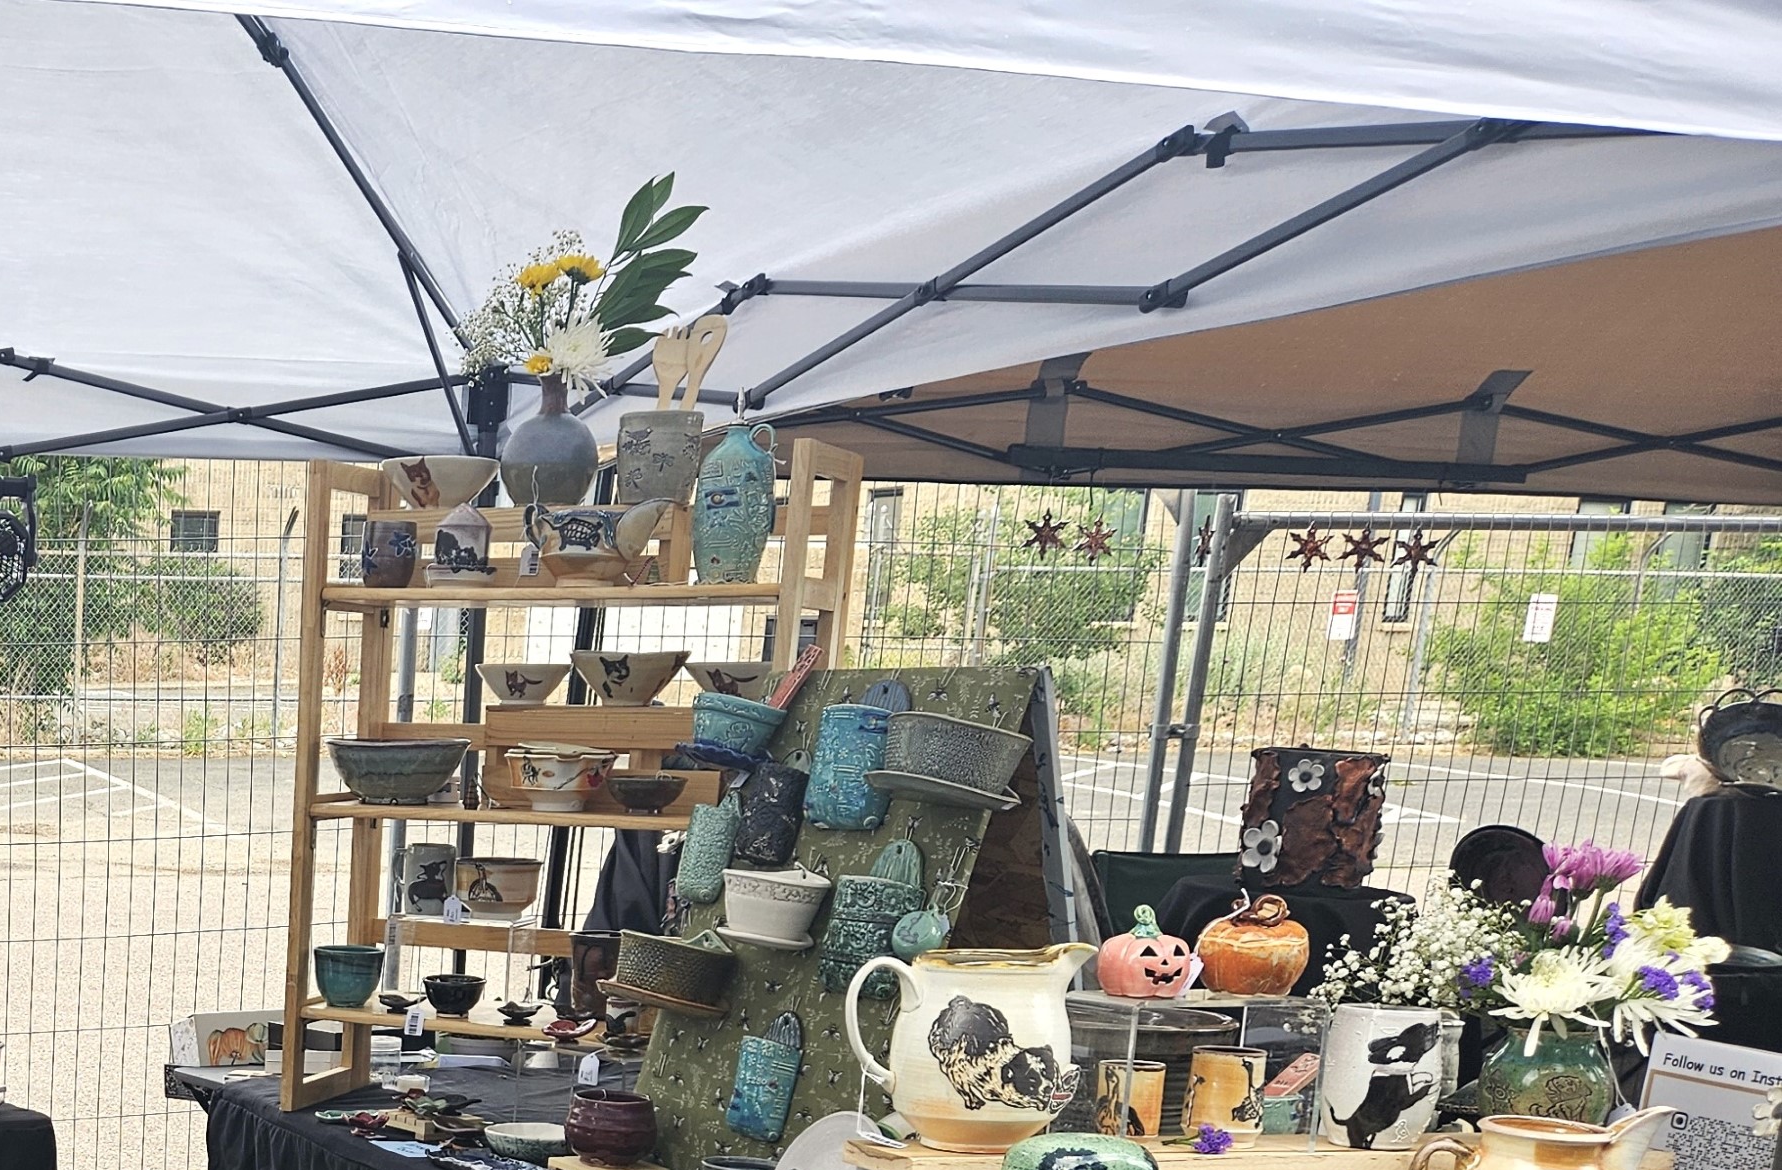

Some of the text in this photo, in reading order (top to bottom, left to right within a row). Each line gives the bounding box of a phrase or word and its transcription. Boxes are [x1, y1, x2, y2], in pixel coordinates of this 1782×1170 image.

[1663, 1053, 1705, 1072] Follow
[1709, 1065, 1725, 1076] us
[1729, 1069, 1746, 1080] on
